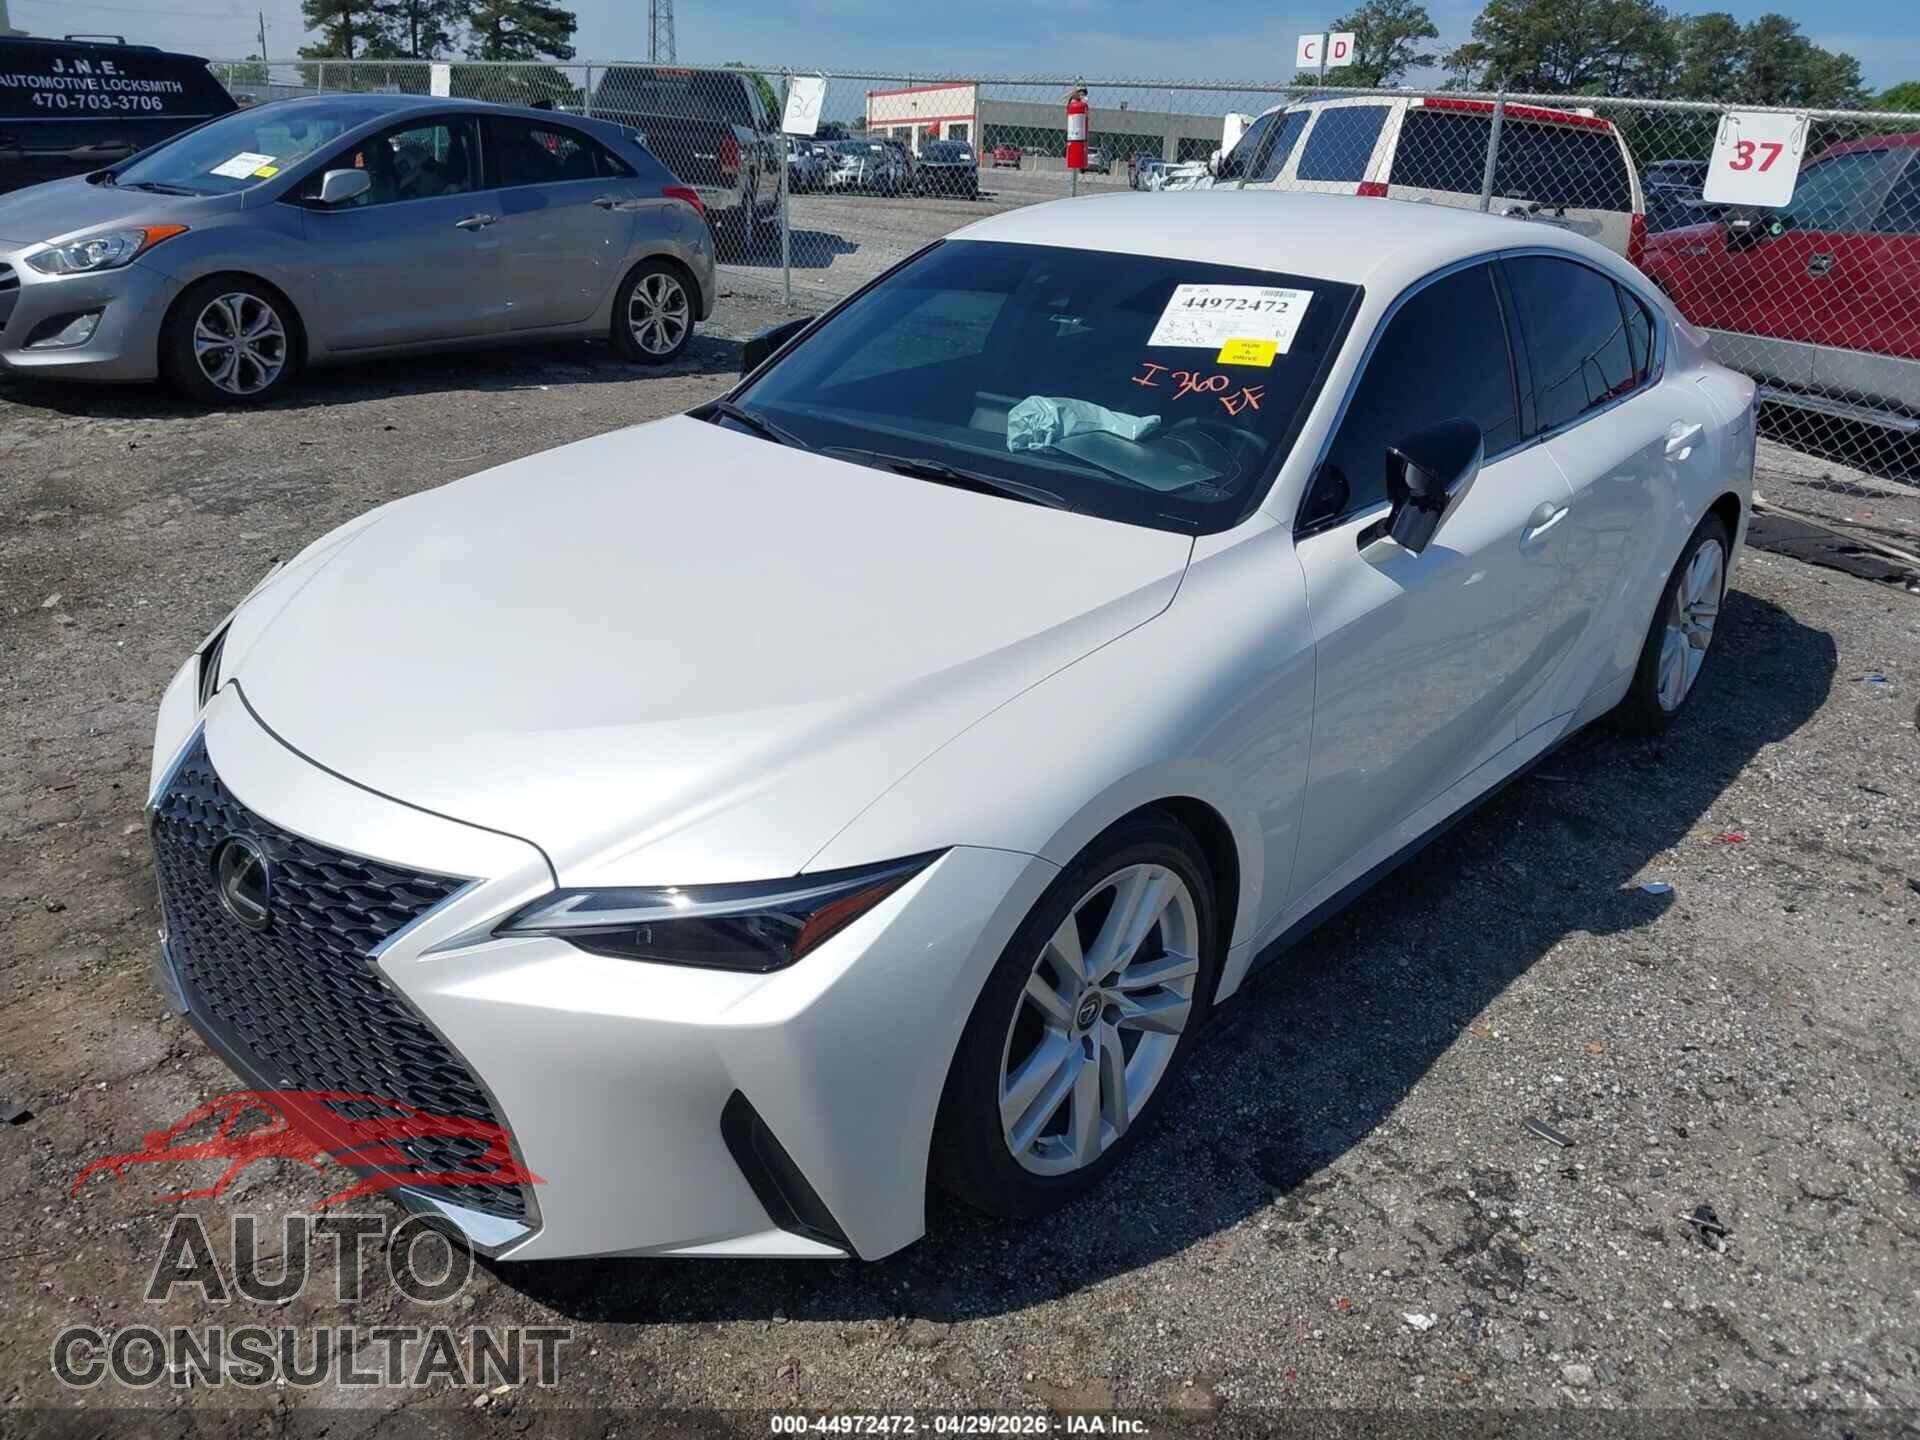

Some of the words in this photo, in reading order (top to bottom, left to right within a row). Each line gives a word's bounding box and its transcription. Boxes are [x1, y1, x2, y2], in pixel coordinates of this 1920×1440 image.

[1305, 42, 1315, 59] C
[1334, 41, 1347, 58] D
[52, 58, 125, 75] J.N.E.
[0, 74, 99, 91] AUTOMOTIVE
[101, 79, 183, 93] LOCKSMITH
[33, 92, 163, 110] 470-703-3706
[1728, 140, 1784, 172] 37
[1181, 296, 1289, 313] 44972472
[1171, 371, 1229, 400] 360
